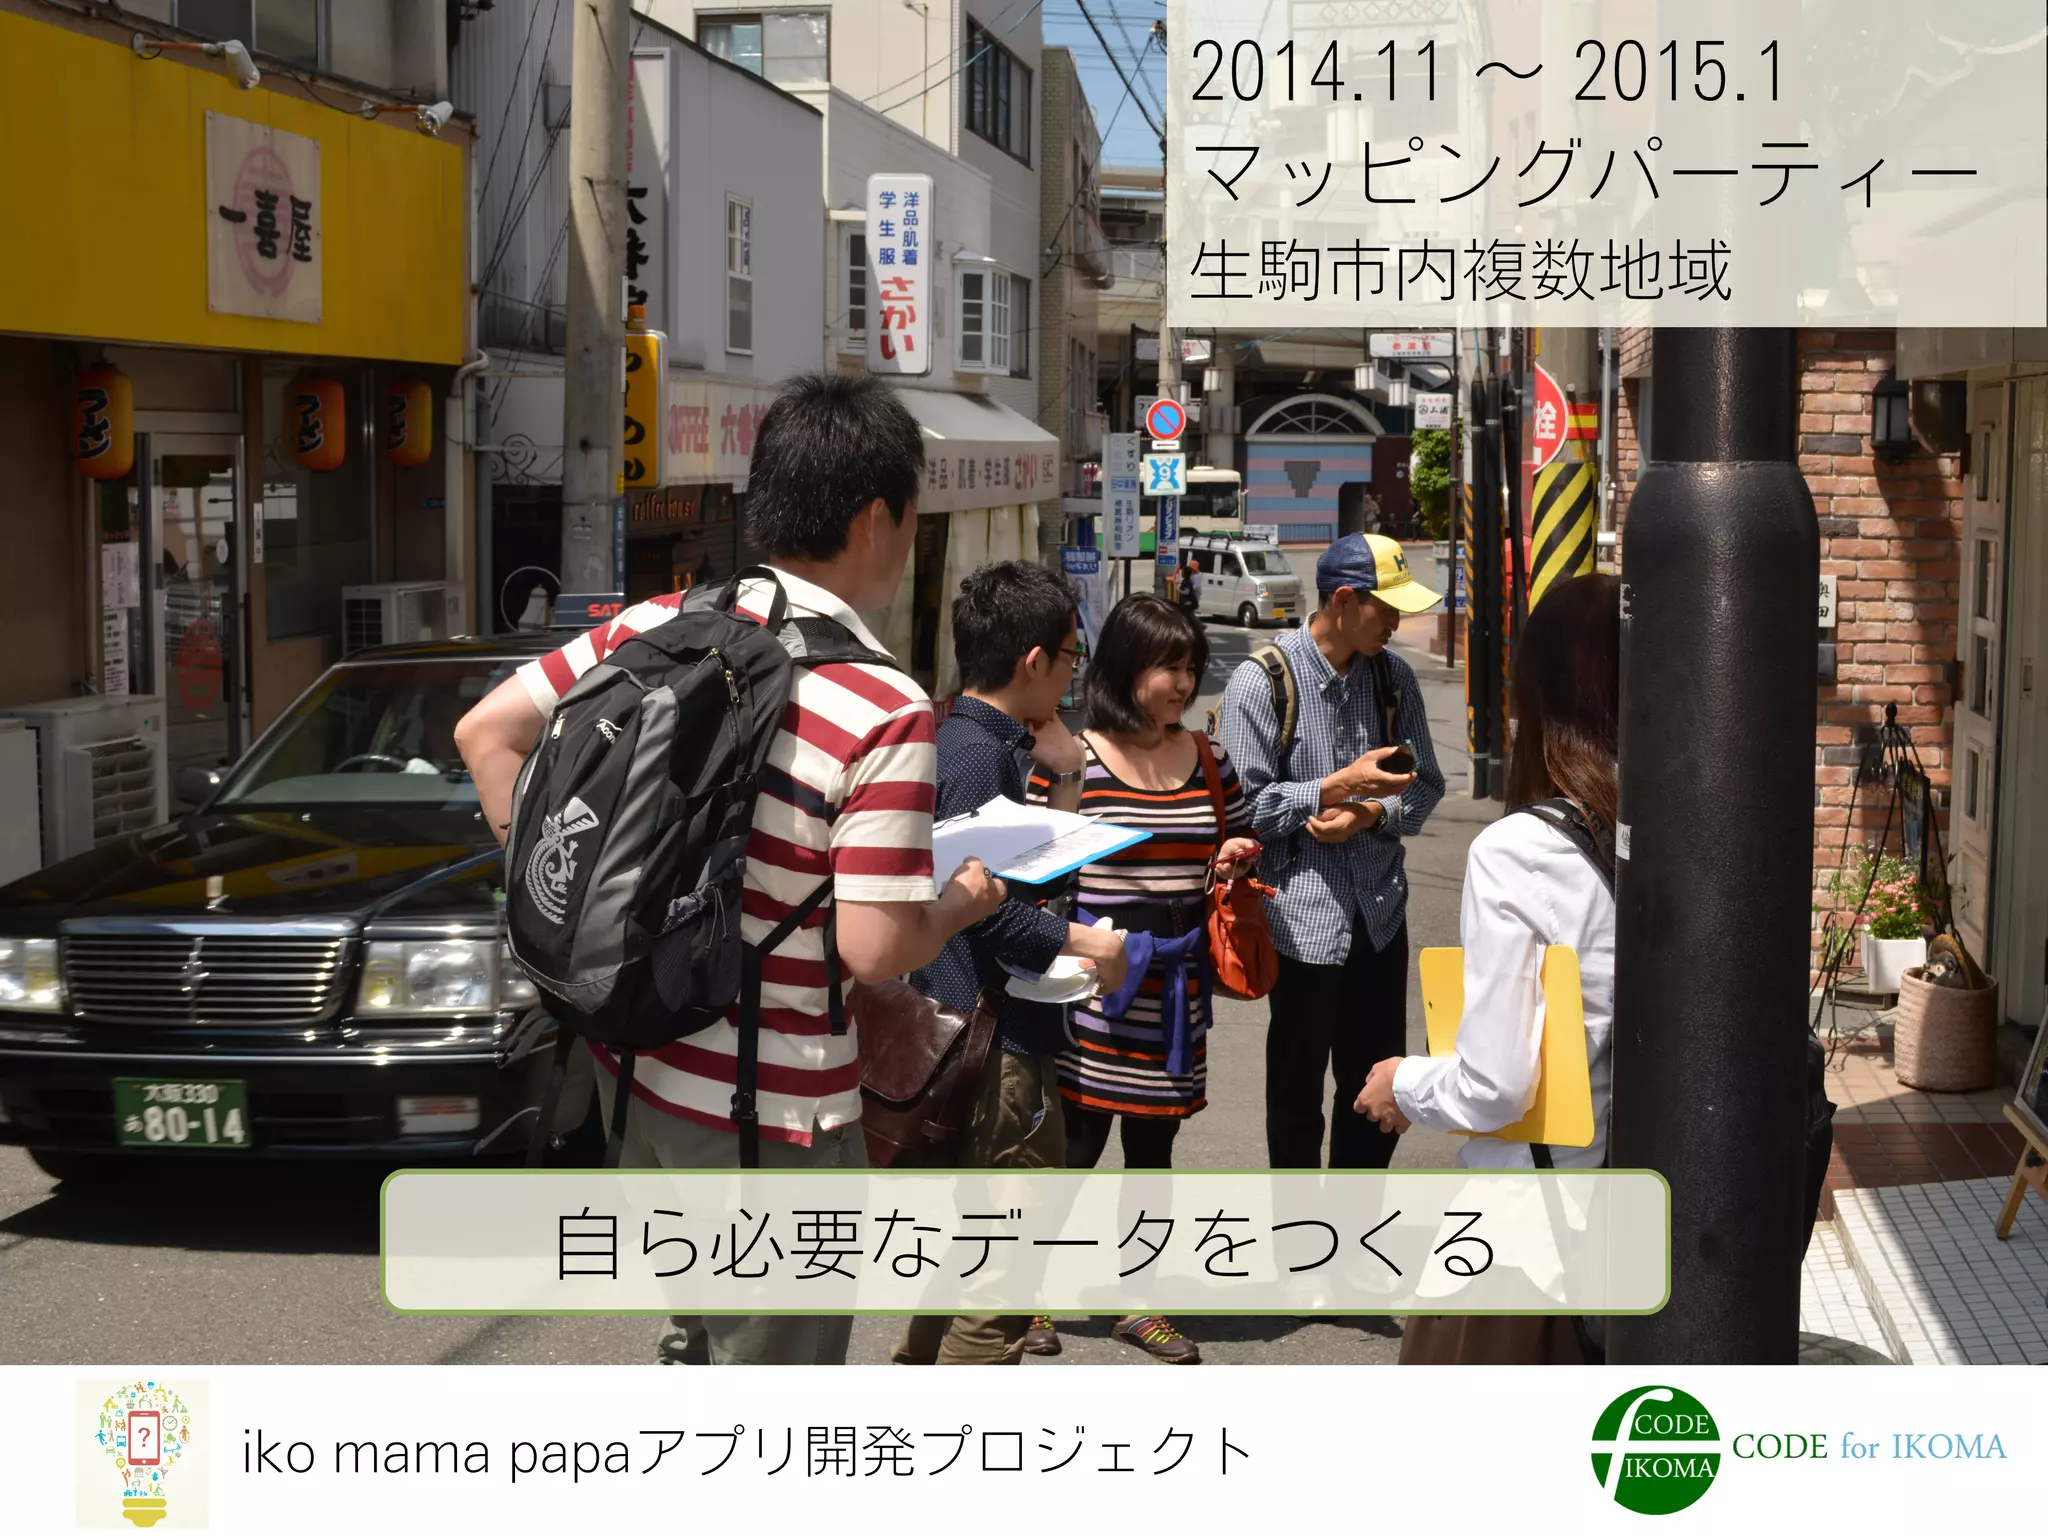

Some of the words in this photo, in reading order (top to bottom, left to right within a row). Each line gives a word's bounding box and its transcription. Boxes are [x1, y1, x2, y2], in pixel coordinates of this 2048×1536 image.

[879, 191, 896, 266] 学生服
[879, 276, 917, 360] さかい
[1534, 400, 1557, 439] 栓
[1127, 437, 1136, 472] くすり
[1159, 465, 1173, 481] 9
[143, 1105, 246, 1144] 80-14
